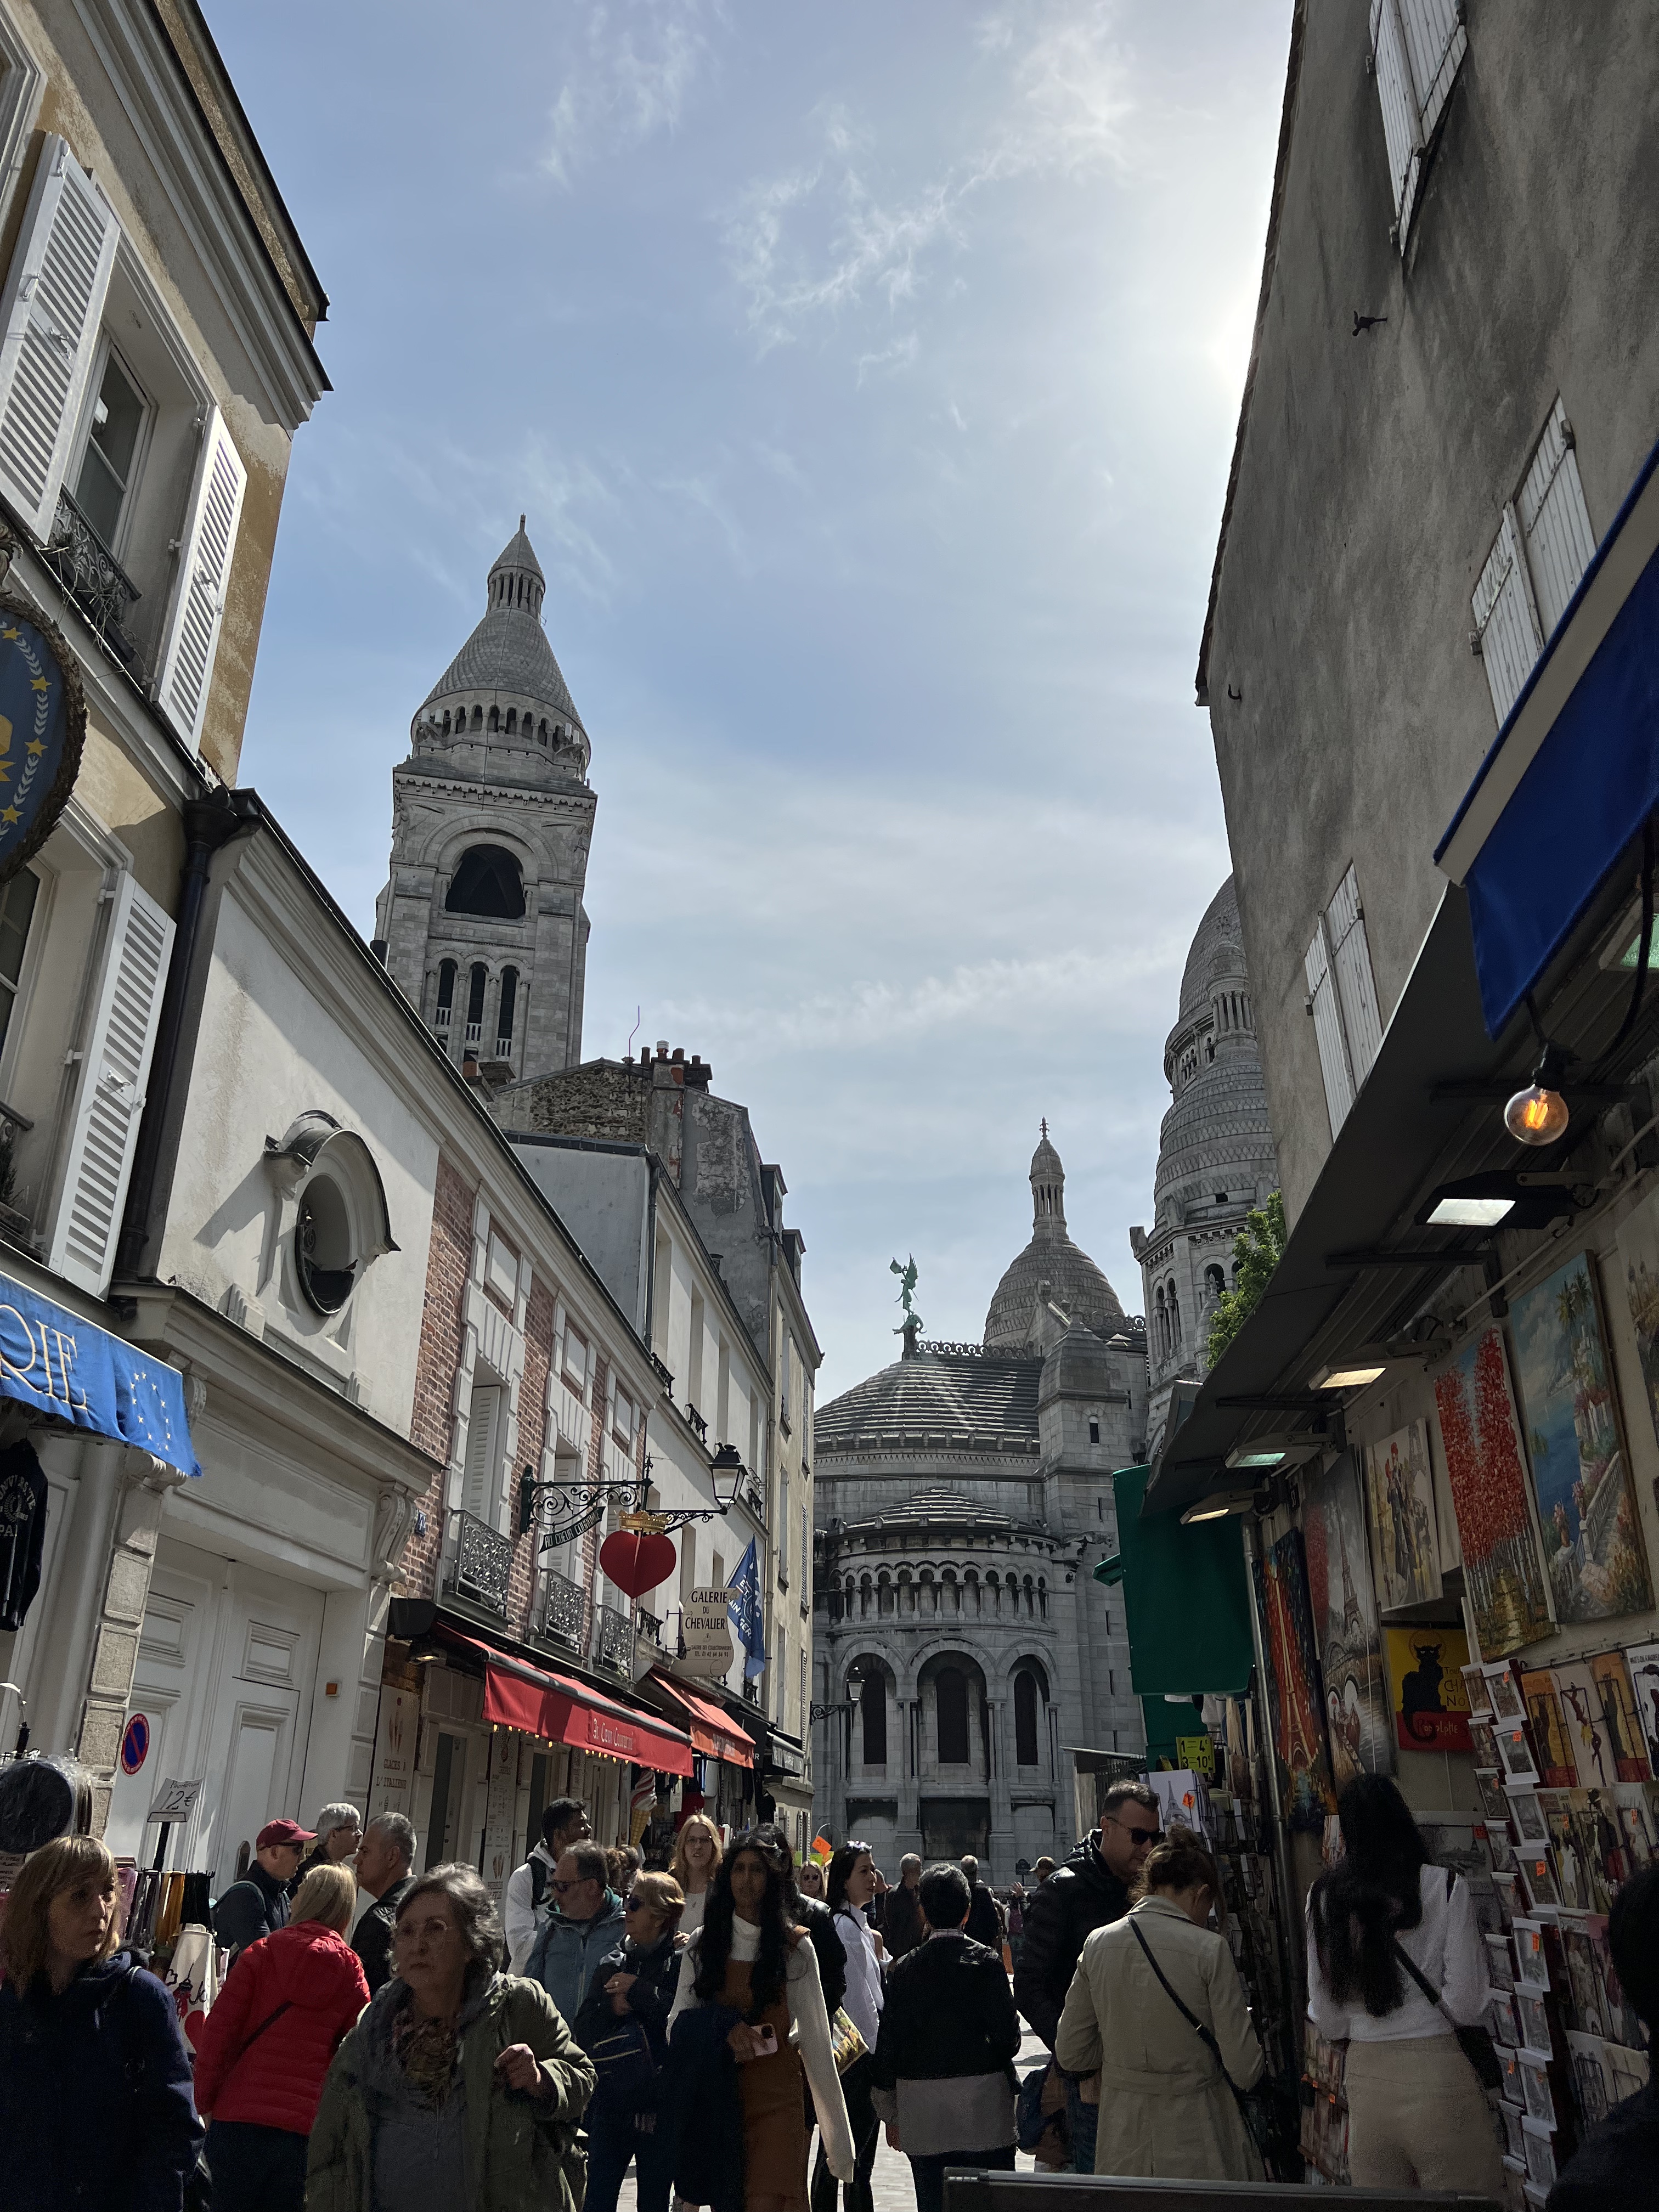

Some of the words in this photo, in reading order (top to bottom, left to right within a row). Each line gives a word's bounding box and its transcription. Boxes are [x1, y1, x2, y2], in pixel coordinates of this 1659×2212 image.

[545, 1535, 553, 1548] AU
[555, 1528, 574, 1544] COEUR
[691, 1590, 728, 1604] GALERIE
[702, 1606, 710, 1615] DU
[685, 1617, 725, 1630] CHEVALIER
[1181, 1740, 1186, 1753] 1
[1181, 1756, 1189, 1770] 3
[159, 1790, 197, 1810] 12€
